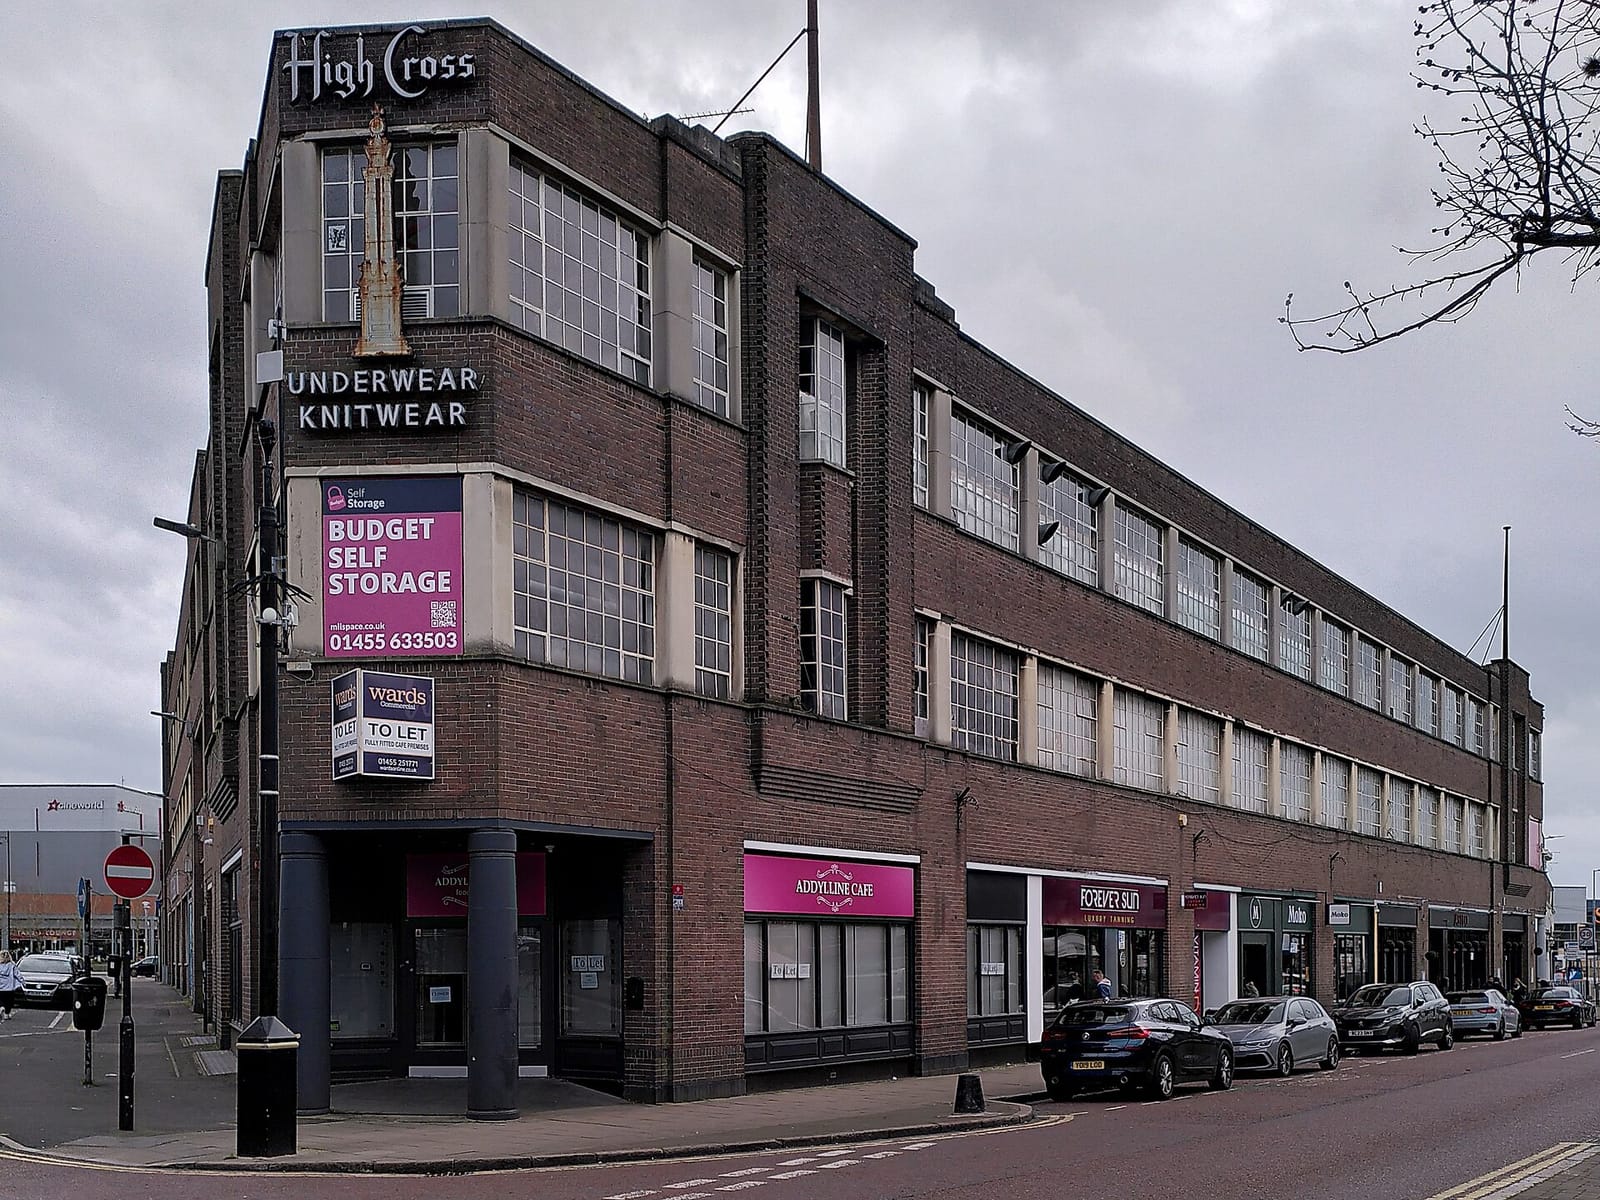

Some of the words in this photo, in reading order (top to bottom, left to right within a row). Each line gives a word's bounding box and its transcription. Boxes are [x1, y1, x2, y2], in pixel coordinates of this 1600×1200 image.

[282, 31, 374, 101] High
[384, 25, 475, 98] Cross
[288, 367, 478, 394] UNDERWEAR
[300, 402, 466, 429] KNITWEAR
[347, 488, 366, 498] Self
[347, 499, 385, 510] Storage
[329, 518, 435, 542] BUDGET
[328, 546, 387, 569] SELF
[328, 571, 451, 595] STORAGE
[330, 633, 385, 650] 01455
[390, 632, 457, 649] 633503
[368, 686, 426, 705] wards
[380, 700, 416, 710] Commercial
[335, 725, 344, 739] TO
[345, 720, 357, 736] LET
[368, 722, 392, 737] TO
[397, 726, 427, 741] LET
[380, 740, 394, 748] FITTED
[378, 757, 397, 766] 01455
[398, 759, 418, 768] 251771
[58, 800, 105, 810] cineworld
[435, 877, 469, 886] ADDYL
[796, 879, 850, 896] ADDYLLINE
[851, 883, 874, 897] CAFE
[1080, 888, 1120, 909] FOREVER
[1084, 914, 1106, 922] LUXURY
[1110, 915, 1135, 924] TANNING
[1252, 905, 1260, 920] M
[1288, 905, 1307, 924] Moko
[573, 957, 586, 968] To
[589, 957, 603, 968] Let
[773, 965, 782, 975] To
[786, 965, 796, 976] Let
